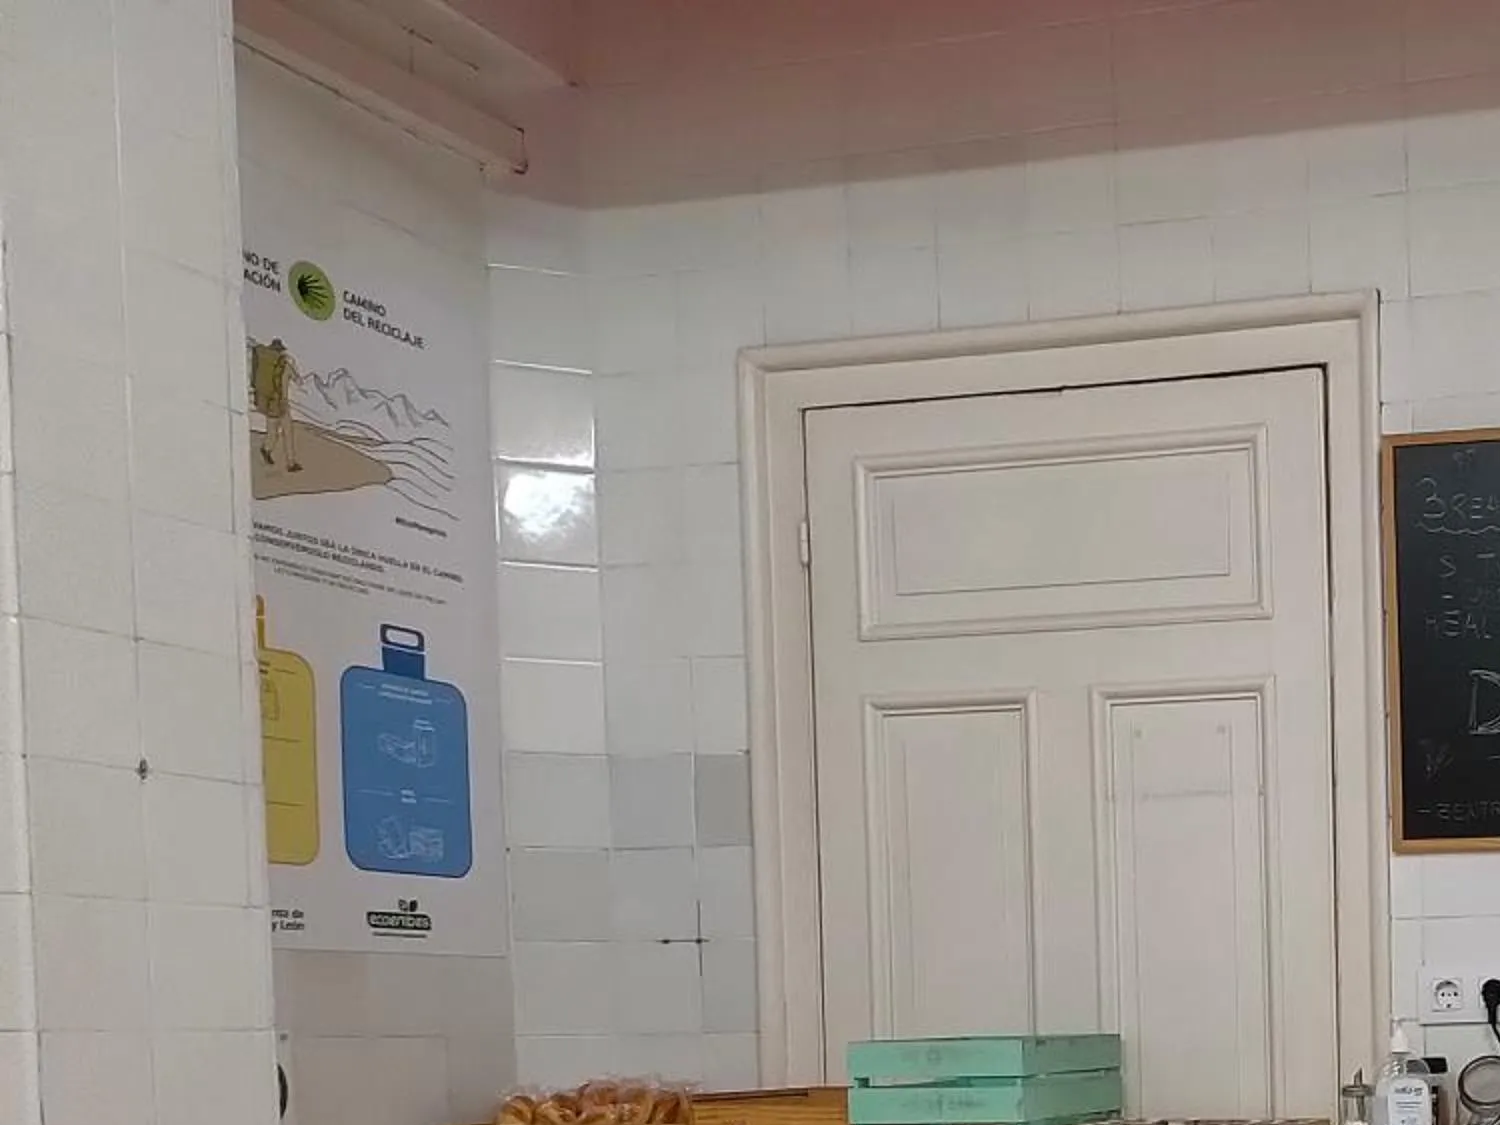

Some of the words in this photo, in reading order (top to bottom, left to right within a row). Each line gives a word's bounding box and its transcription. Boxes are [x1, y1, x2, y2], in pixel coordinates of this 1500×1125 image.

[343, 290, 387, 317] CAMINO
[343, 307, 365, 327] DEL
[367, 317, 425, 349] RECICLAJE
